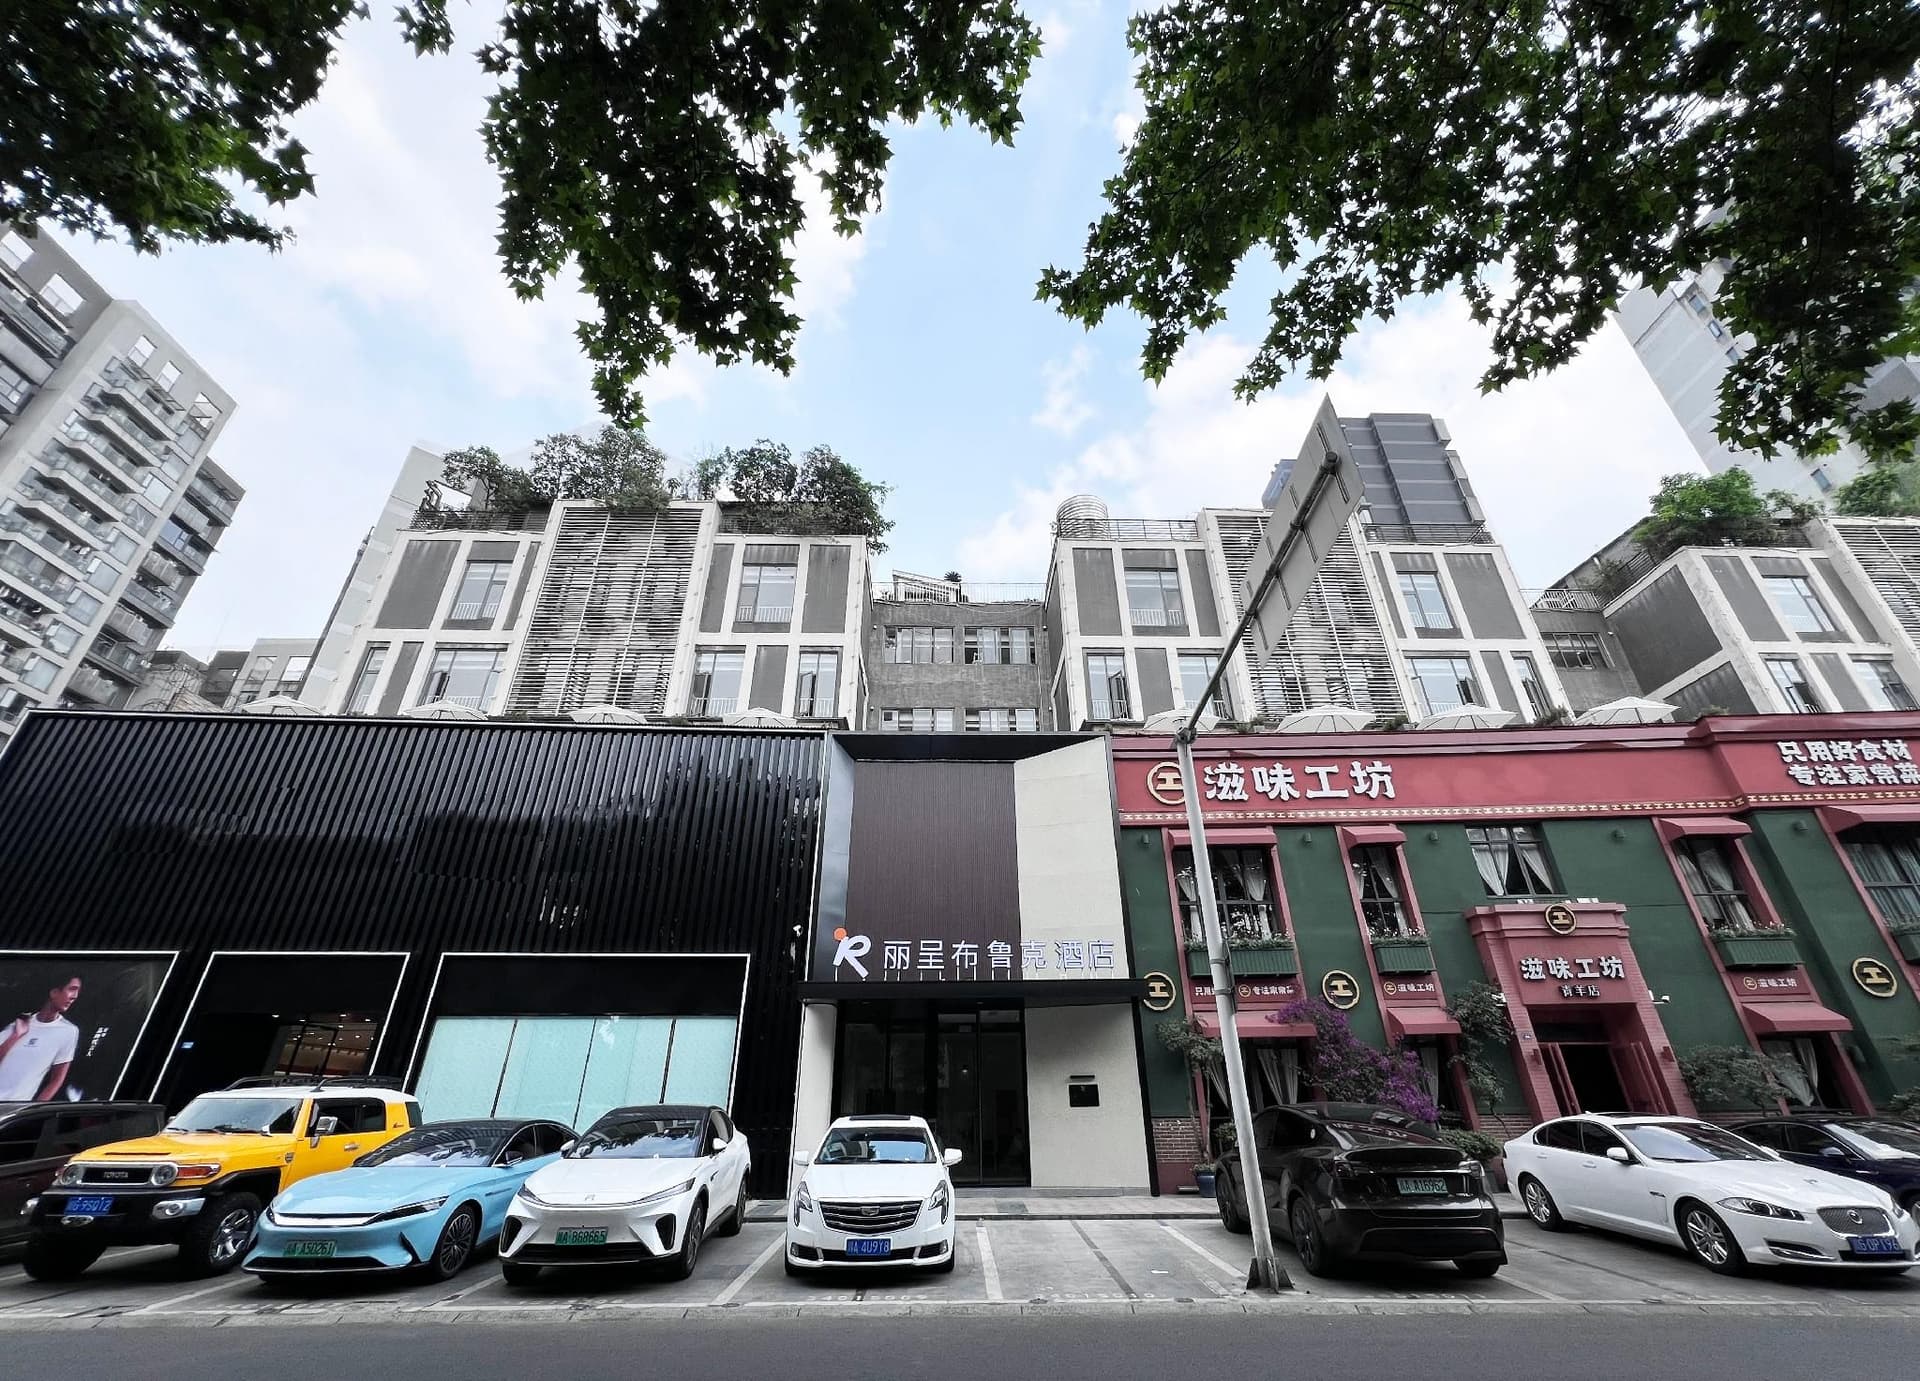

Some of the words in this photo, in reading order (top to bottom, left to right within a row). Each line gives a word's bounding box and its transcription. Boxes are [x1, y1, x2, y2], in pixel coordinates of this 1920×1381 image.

[1777, 739, 1912, 763] 只用好食材
[1203, 761, 1396, 801] 滋味工坊
[1788, 763, 1920, 786] 专注家常菜
[883, 939, 1114, 969] 丽呈布鲁克酒店
[1520, 956, 1625, 980] 滋味工坊
[1561, 984, 1600, 997] 青羊店
